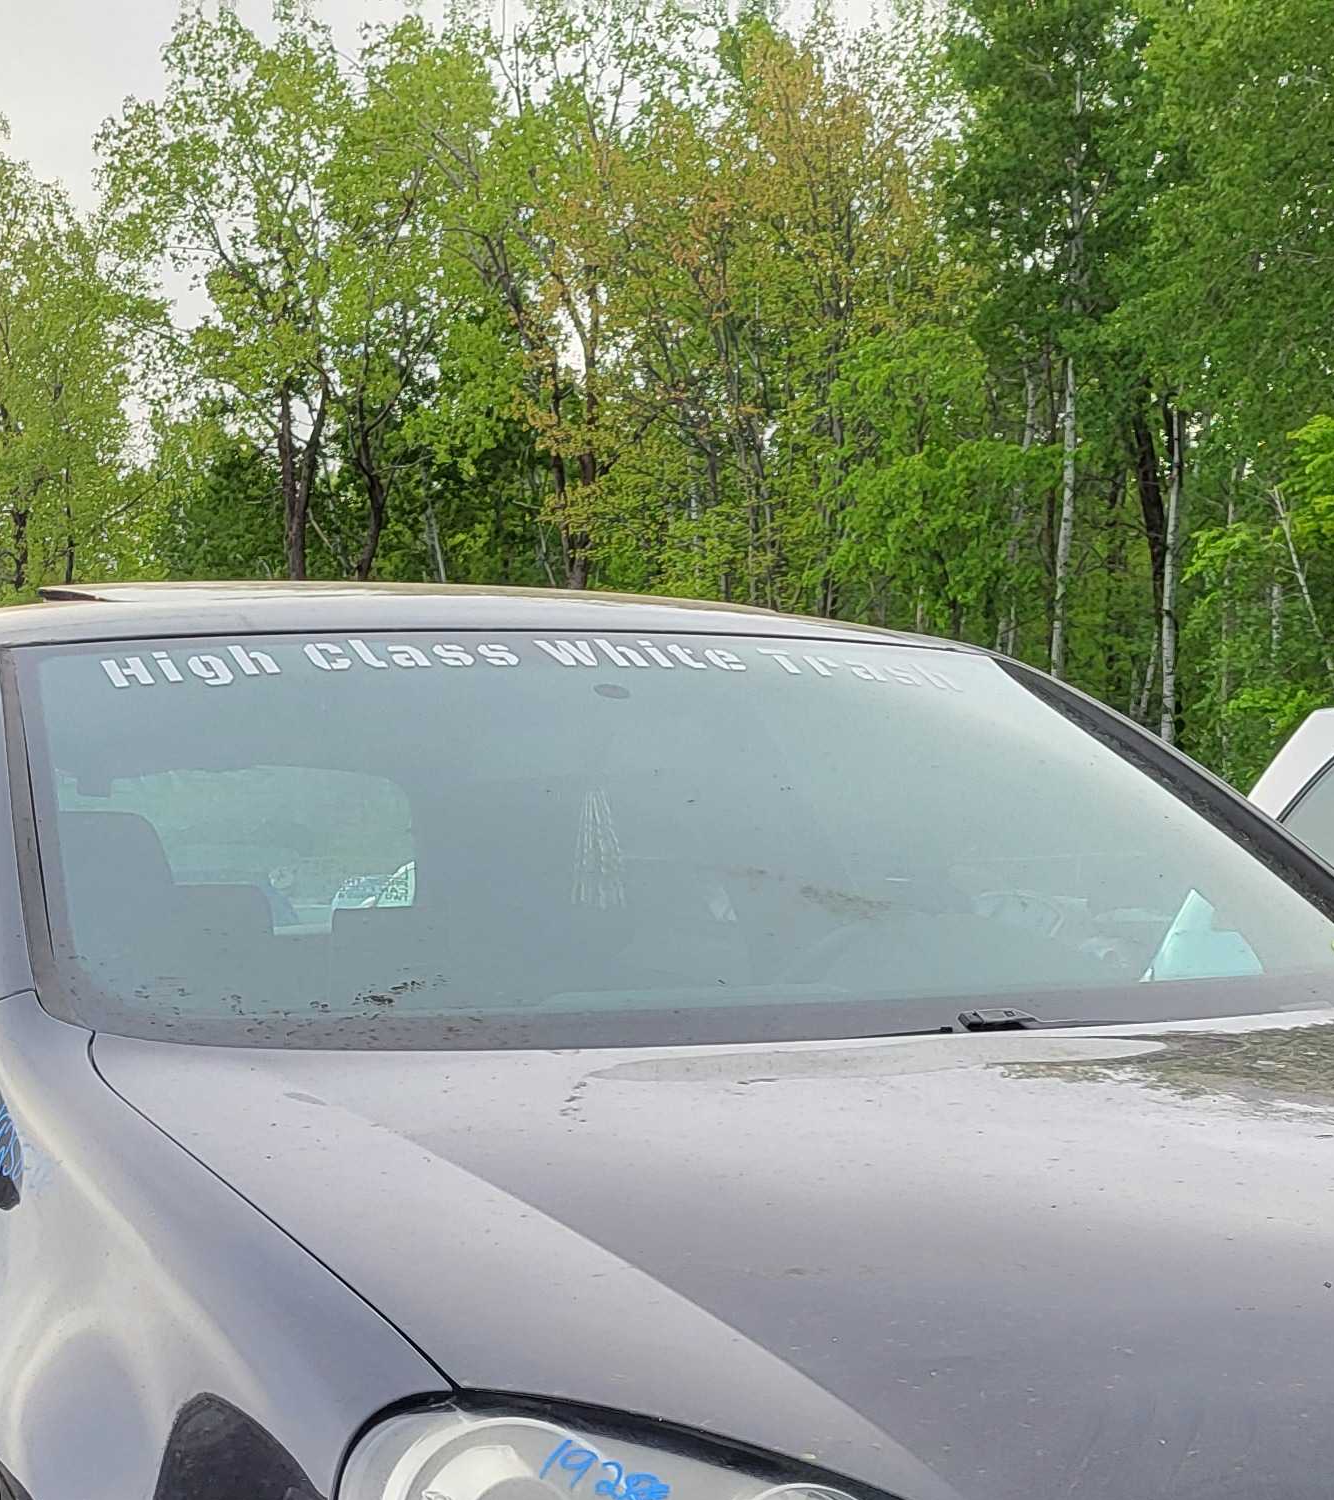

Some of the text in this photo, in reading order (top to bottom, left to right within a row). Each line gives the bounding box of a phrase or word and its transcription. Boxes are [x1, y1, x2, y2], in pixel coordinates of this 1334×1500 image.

[100, 638, 964, 692] High Class White Trash
